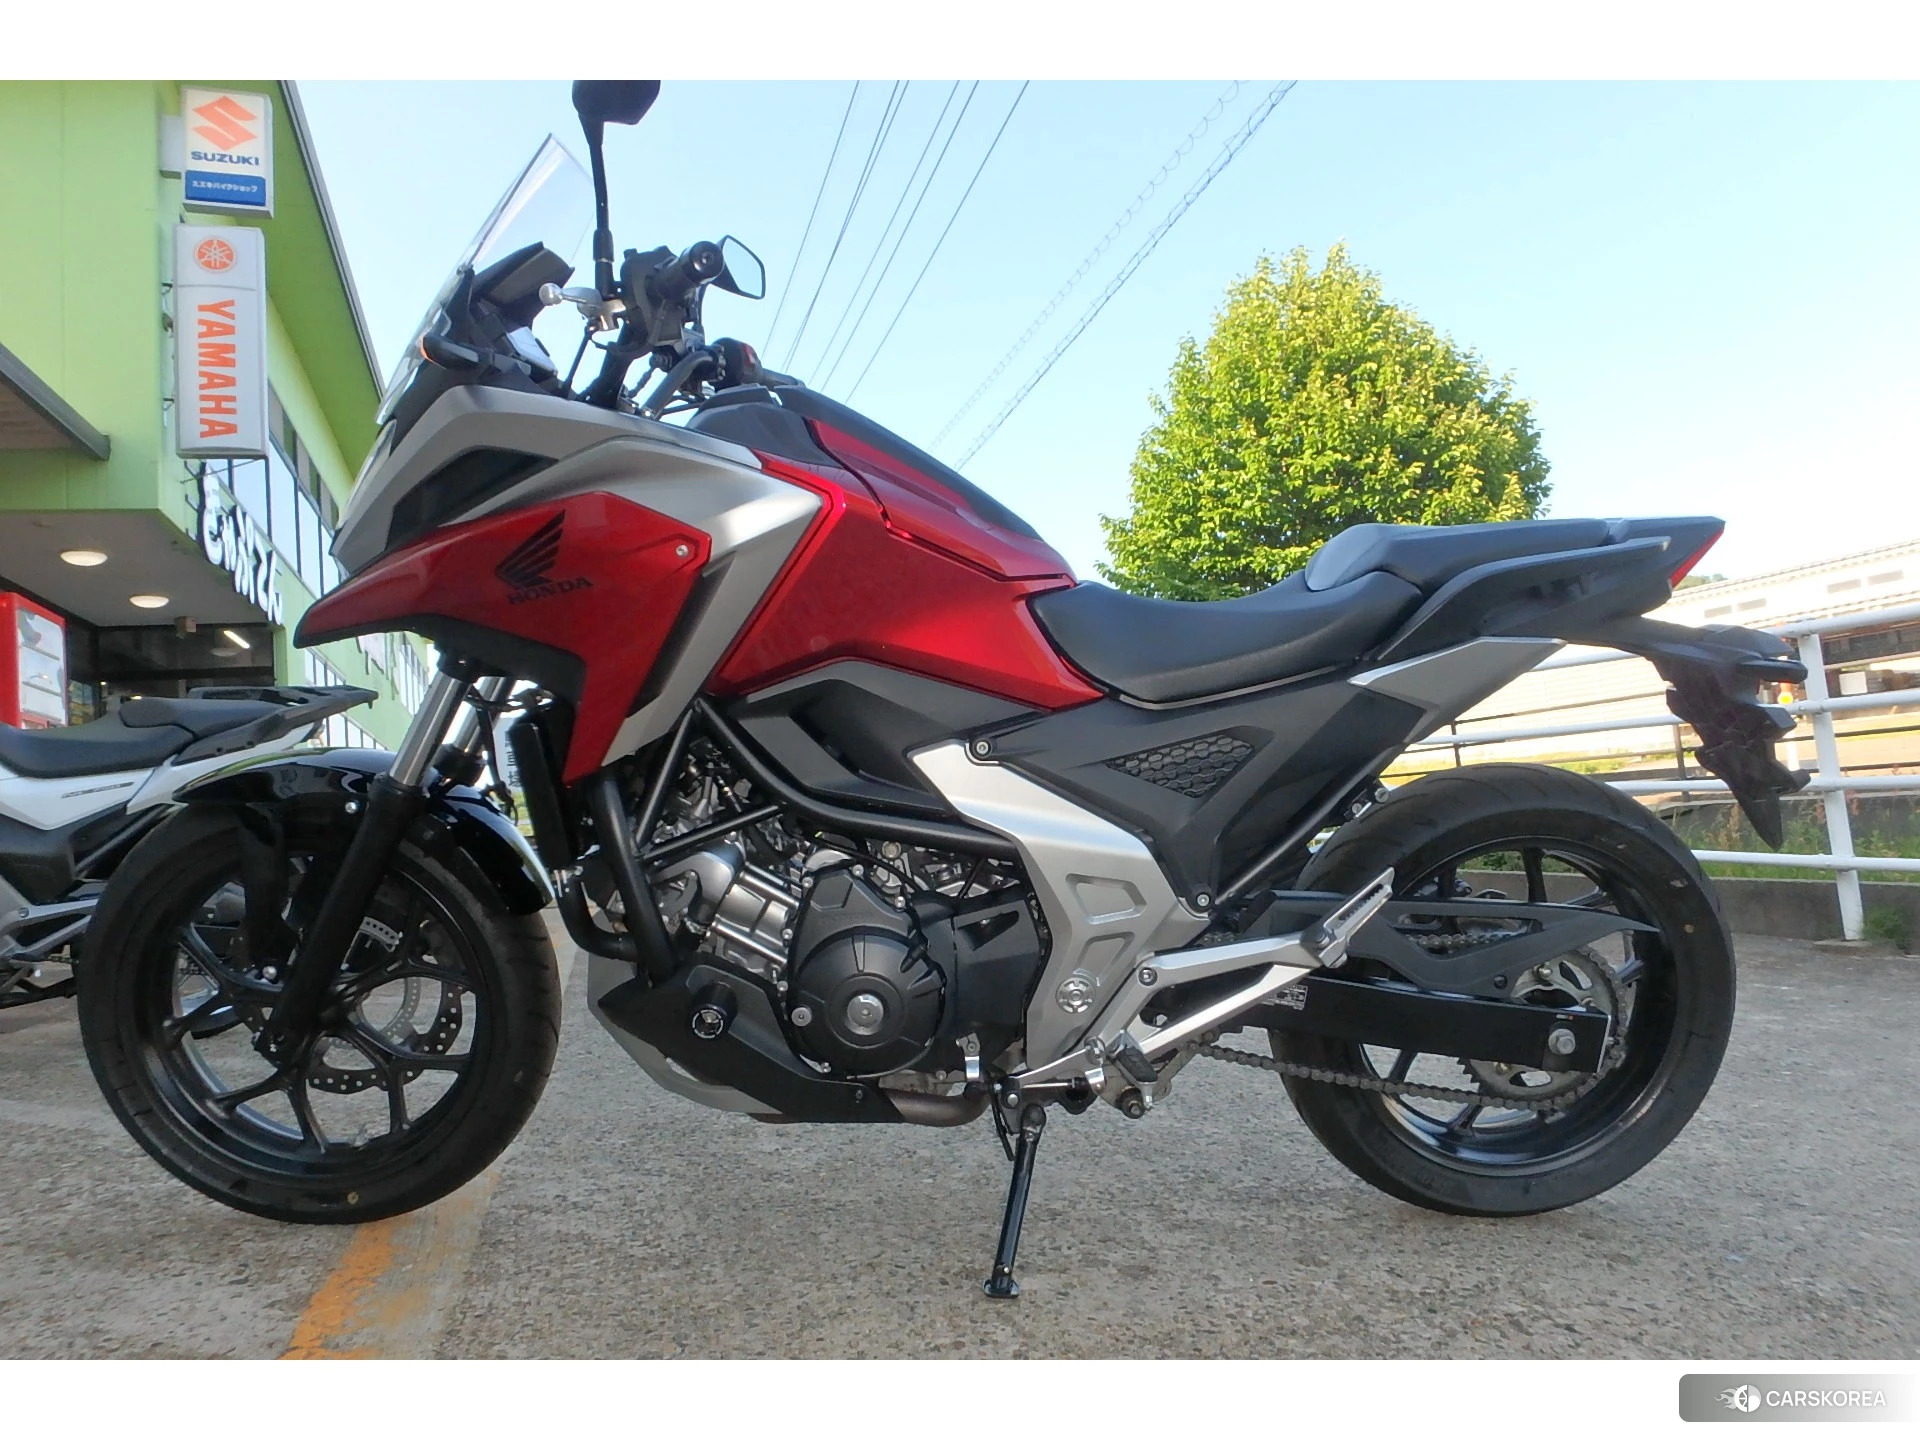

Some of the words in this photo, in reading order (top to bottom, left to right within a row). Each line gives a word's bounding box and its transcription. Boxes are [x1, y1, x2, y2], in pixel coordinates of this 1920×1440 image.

[191, 151, 259, 166] SUZUKI
[197, 299, 239, 439] YAMAHA
[507, 577, 593, 605] HONDA
